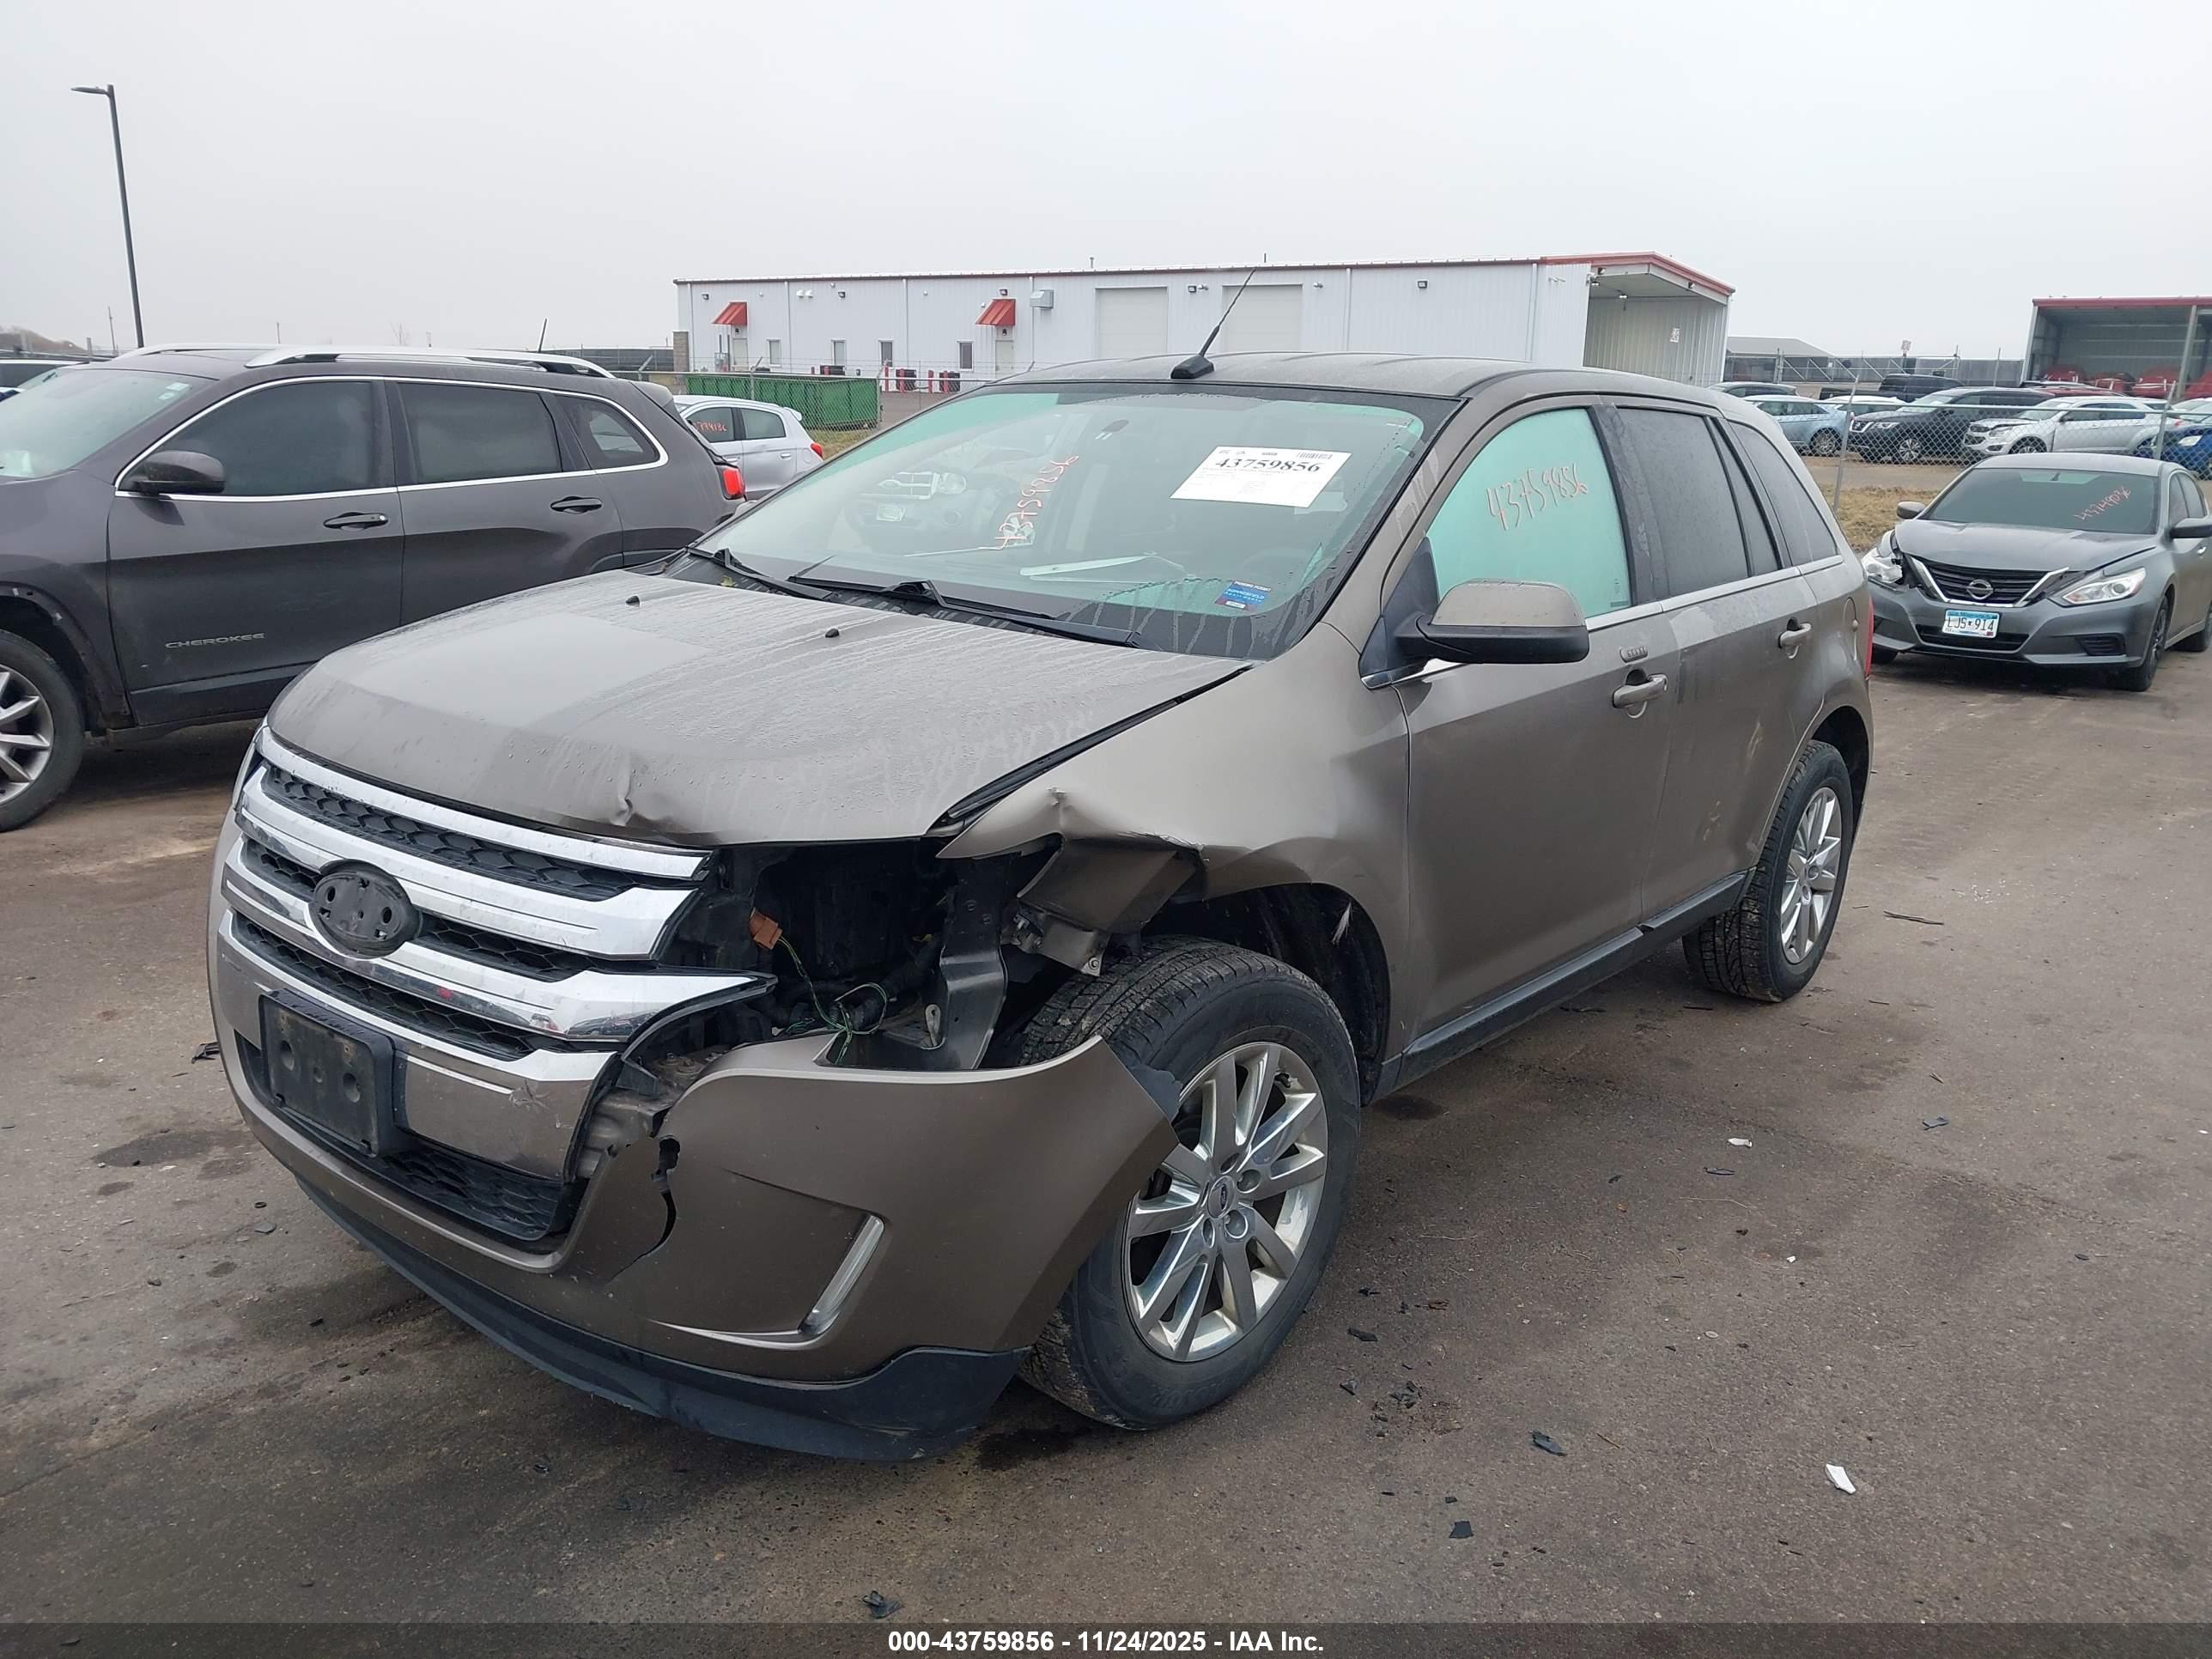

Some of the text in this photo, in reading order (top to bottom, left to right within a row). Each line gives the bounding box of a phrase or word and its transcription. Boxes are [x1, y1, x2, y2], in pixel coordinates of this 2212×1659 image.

[1216, 458, 1326, 472] 43759856
[989, 454, 1080, 550] 43759856
[1486, 462, 1589, 531] 43759856
[1947, 617, 1995, 631] LJS 914
[165, 633, 265, 649] CHEROKEE
